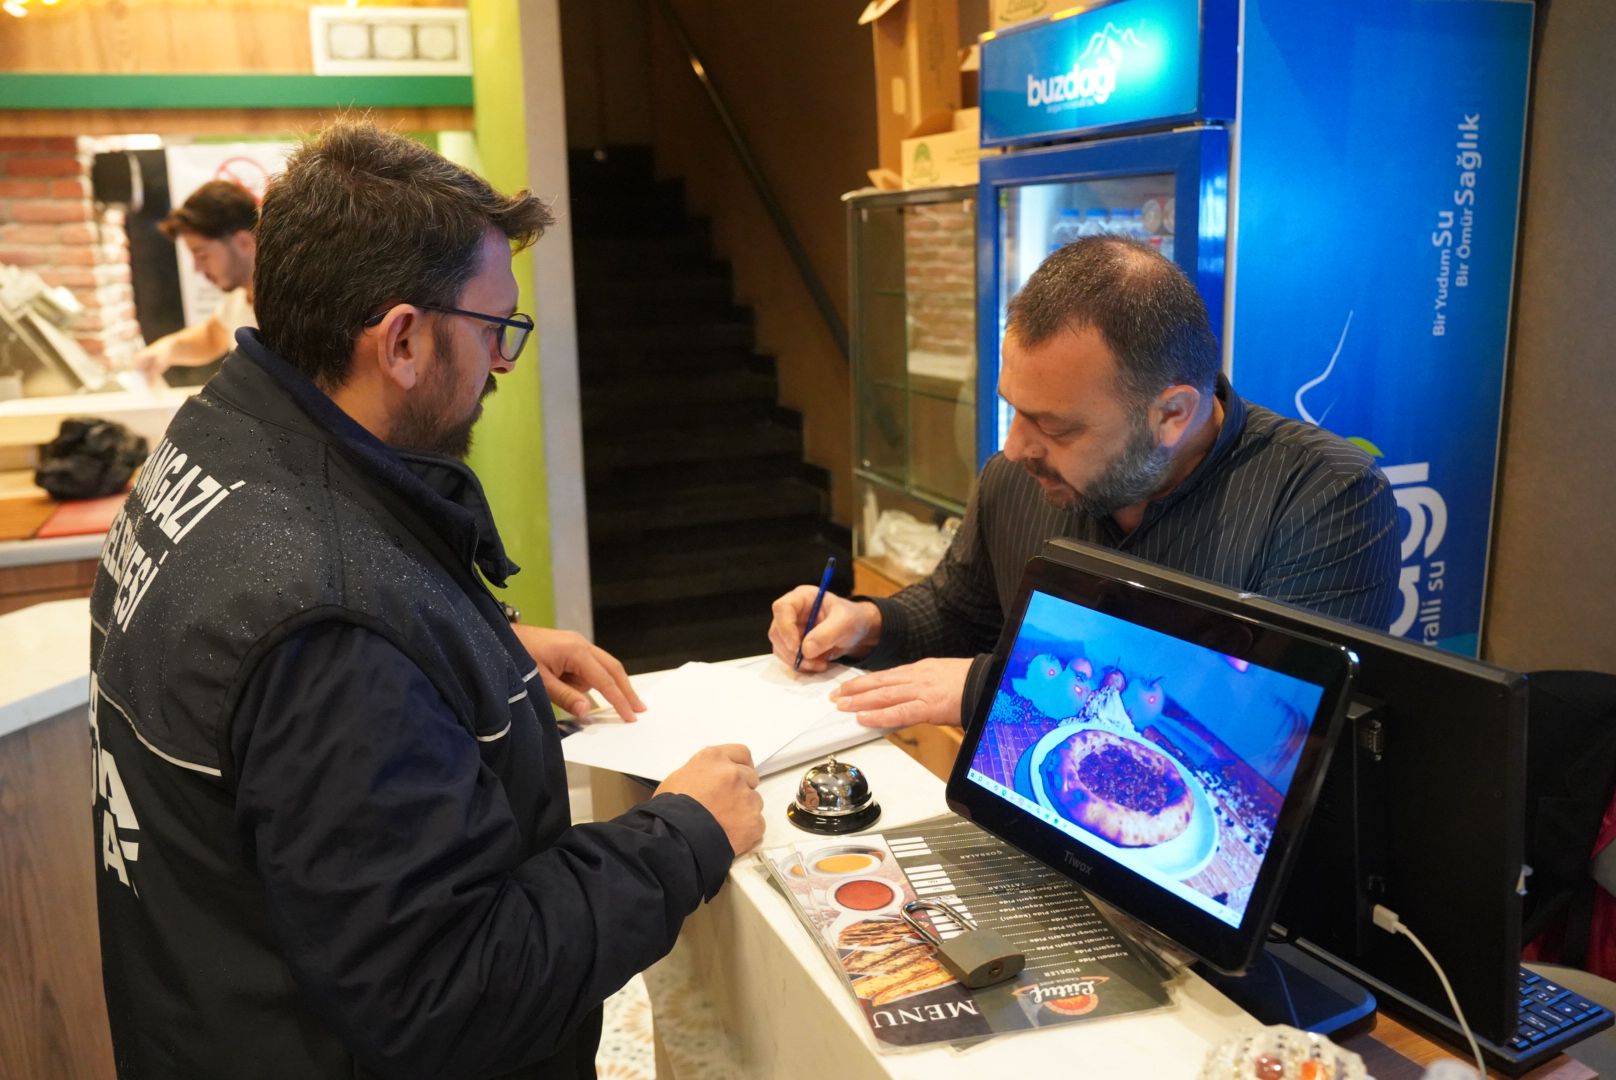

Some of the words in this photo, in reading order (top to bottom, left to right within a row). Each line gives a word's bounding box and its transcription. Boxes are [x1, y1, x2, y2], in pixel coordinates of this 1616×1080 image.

[1454, 113, 1482, 206] Sağlık
[1431, 211, 1454, 247] Su
[1456, 207, 1473, 259] Ömür
[1434, 248, 1451, 311] Yudum
[1455, 263, 1469, 287] Bir
[1432, 313, 1446, 336] Bir
[1428, 560, 1445, 592] su
[1420, 598, 1441, 646] ralli
[960, 850, 1003, 860] ÇORBALAR
[988, 882, 1026, 891] TATLILAR
[1097, 951, 1128, 960] Kıymalı
[1044, 966, 1080, 977] PİDELER
[873, 1000, 979, 1028] MENU
